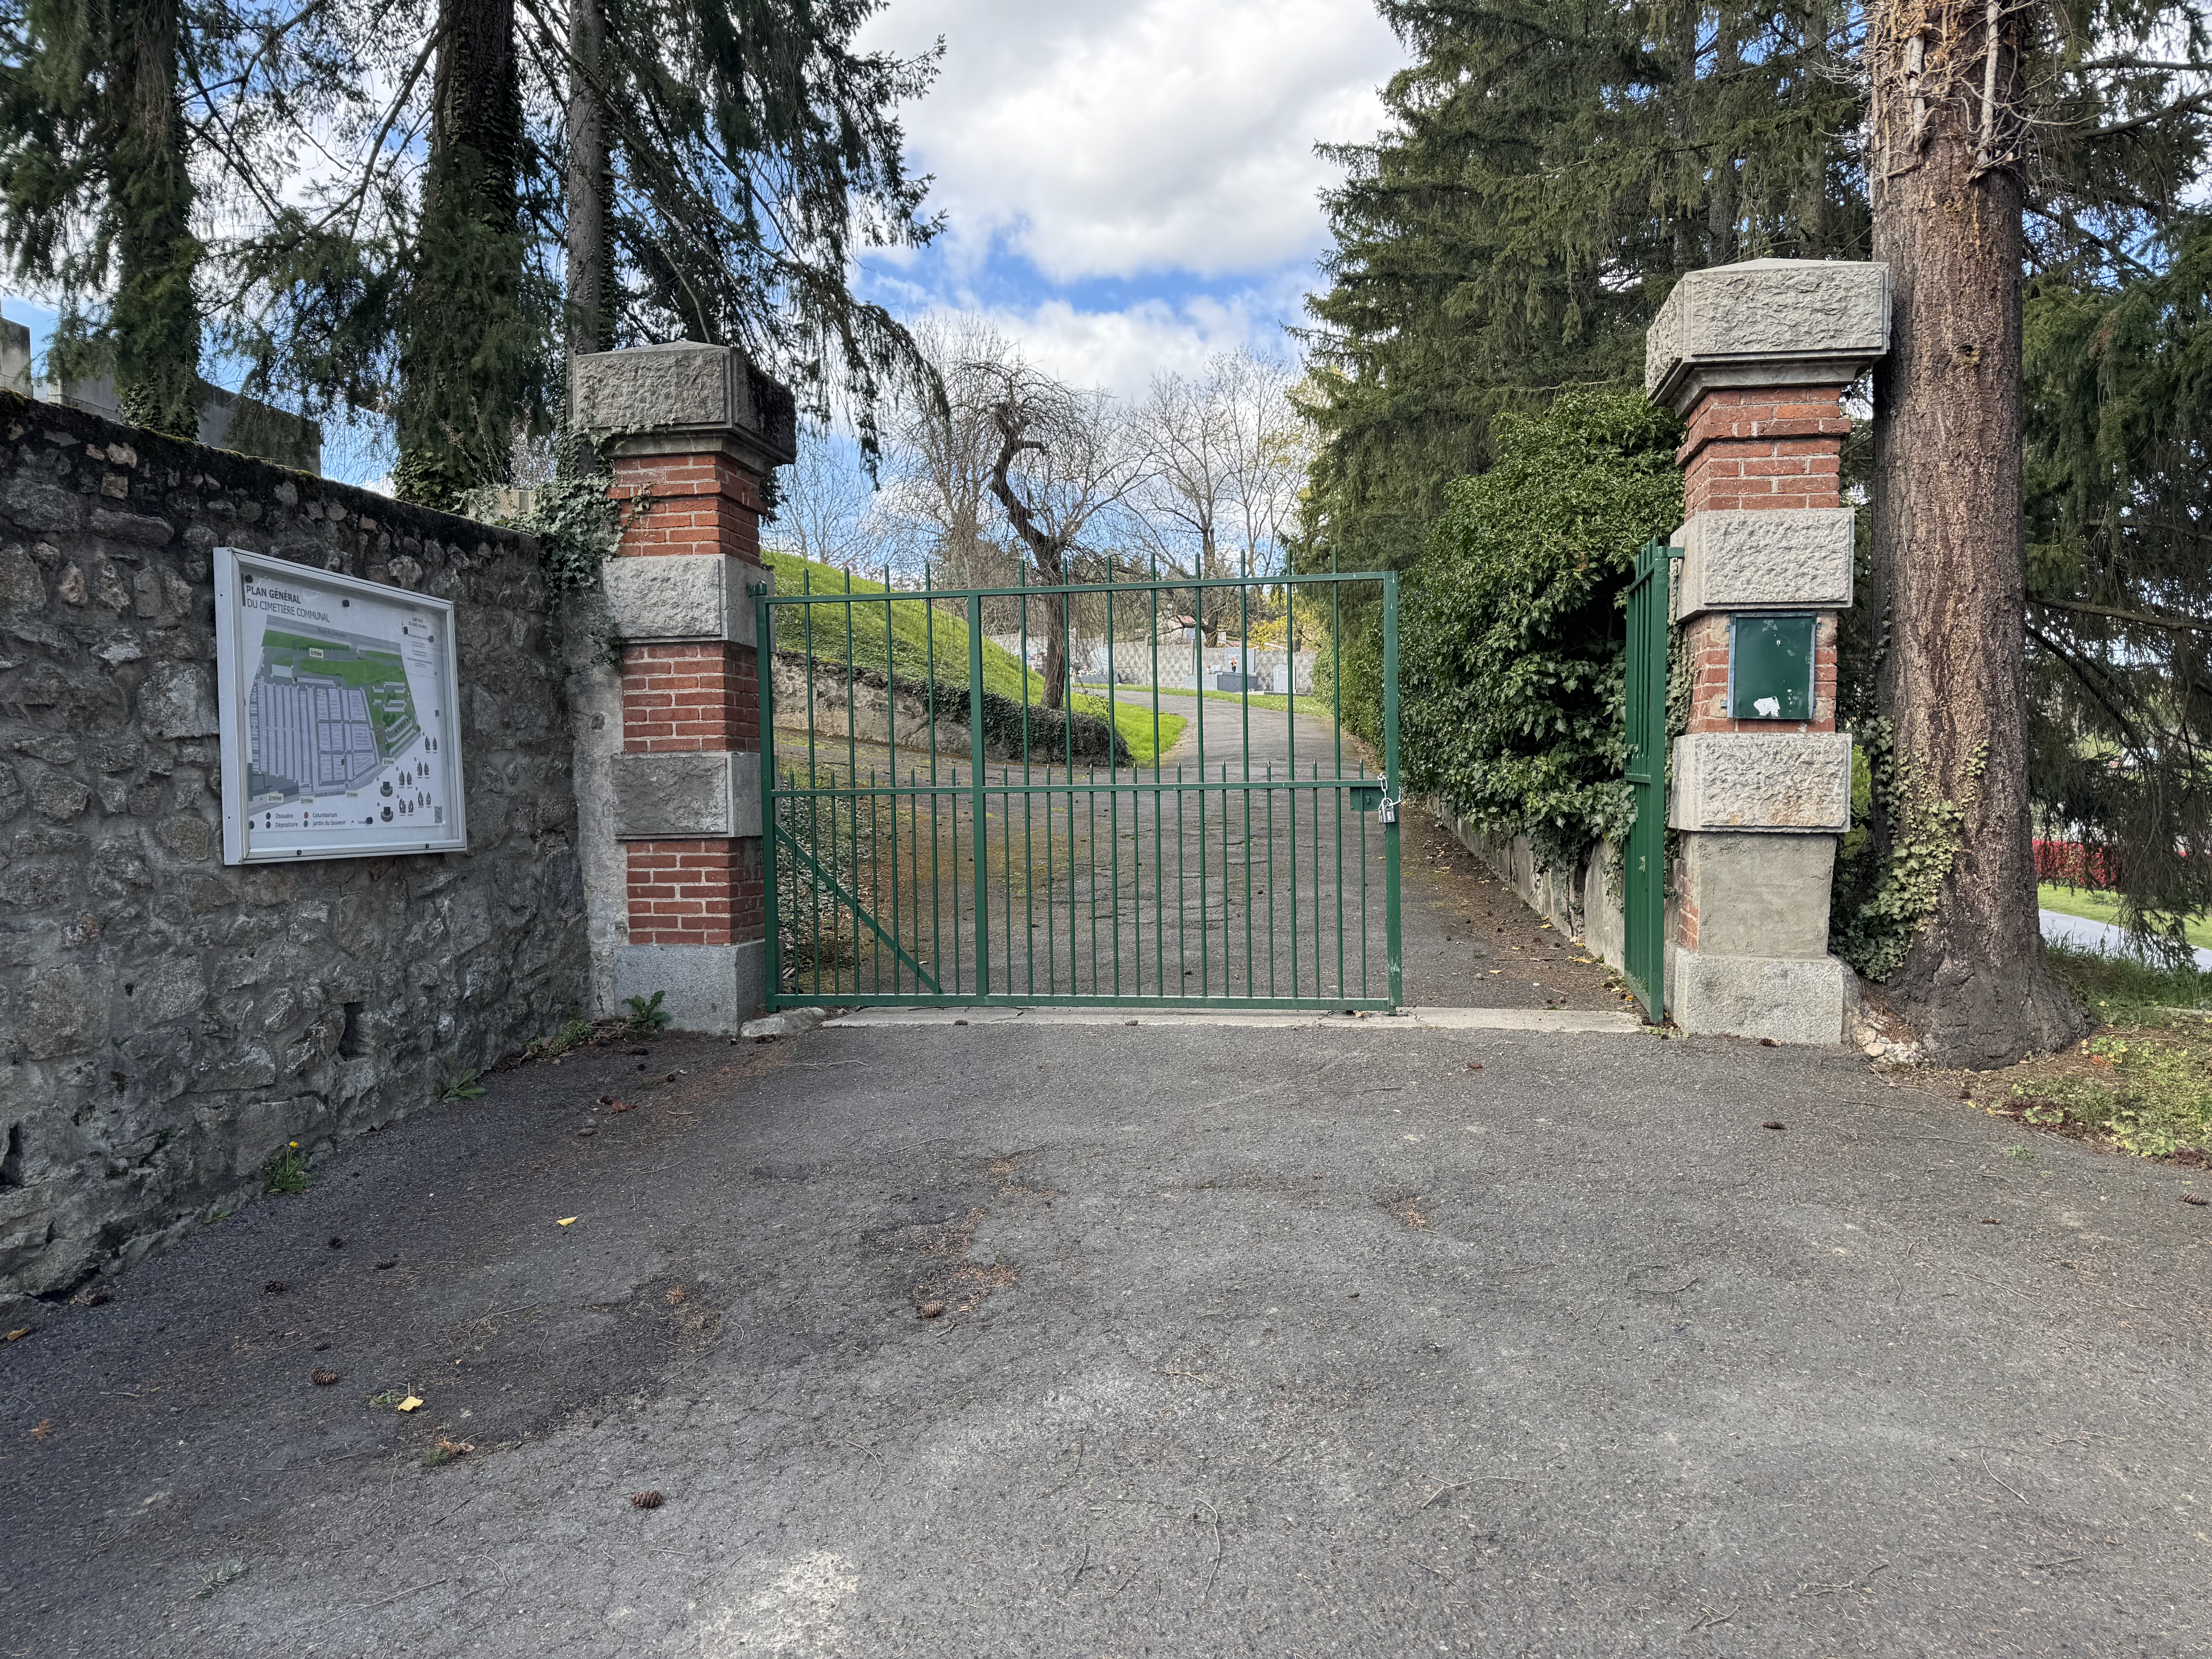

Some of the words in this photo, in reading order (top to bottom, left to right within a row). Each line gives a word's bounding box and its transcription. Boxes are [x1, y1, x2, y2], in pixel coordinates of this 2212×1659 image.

[246, 585, 267, 597] PLAN
[269, 588, 301, 604] GÉNÉRAL
[247, 599, 258, 608] DU
[260, 601, 295, 615] CIMETIÈRE
[297, 608, 330, 622] COMMUNAL
